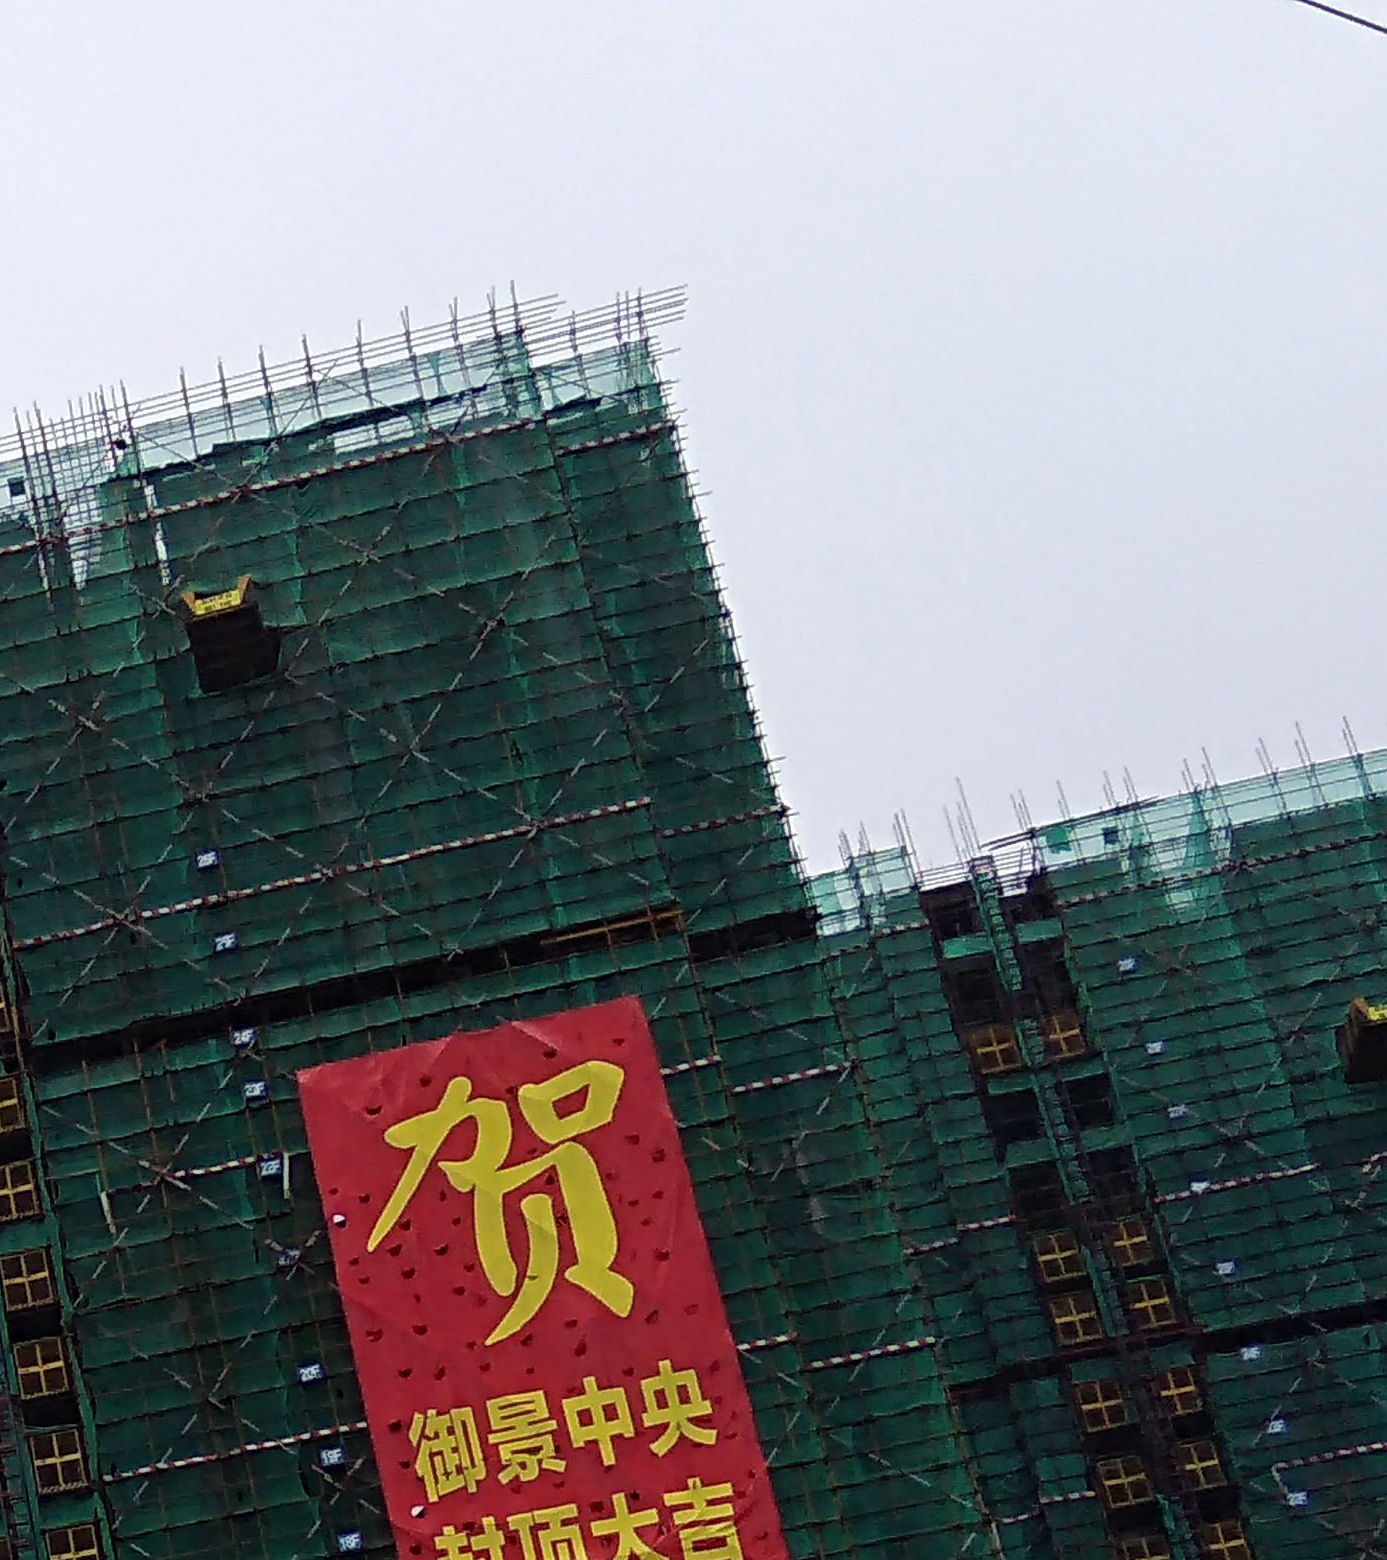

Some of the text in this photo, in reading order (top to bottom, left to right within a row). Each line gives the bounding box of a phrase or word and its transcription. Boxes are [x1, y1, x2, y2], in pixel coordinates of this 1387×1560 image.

[368, 1060, 634, 1346] 贺
[408, 1359, 719, 1502] 御景中央
